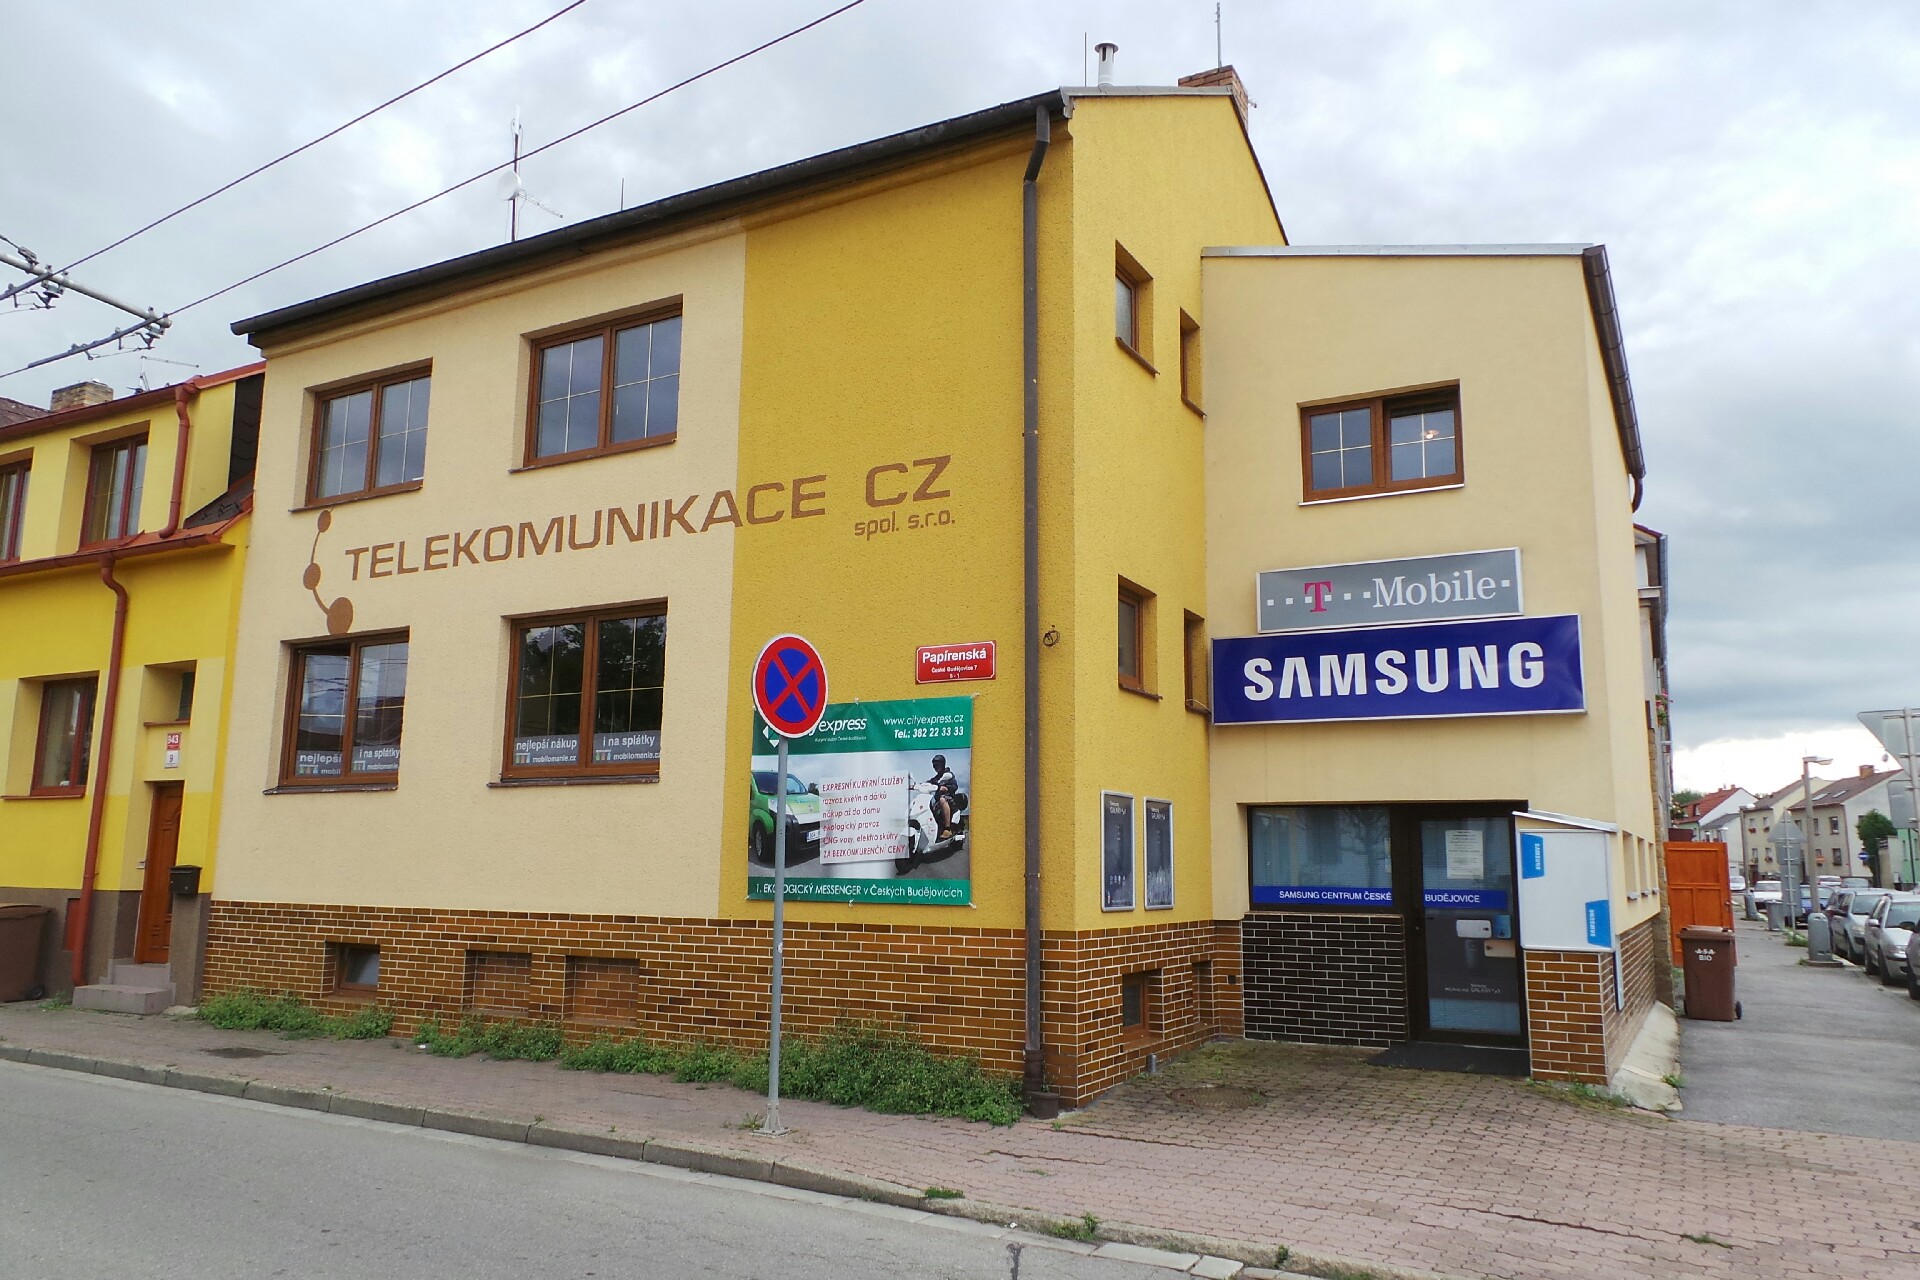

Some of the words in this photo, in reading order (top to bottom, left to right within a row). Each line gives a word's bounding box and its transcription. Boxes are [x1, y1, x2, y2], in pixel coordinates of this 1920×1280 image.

[345, 474, 827, 581] TELEKOMUNIKACE
[865, 454, 952, 509] CZ
[855, 510, 899, 541] spol.
[908, 509, 955, 530] s.r.o.
[1372, 569, 1496, 608] Mobile
[922, 648, 986, 664] Papírenská
[1244, 642, 1544, 702] SAMSUNG
[883, 714, 964, 726] www.cityexpress.cz
[894, 729, 910, 738] Tel.:
[912, 728, 927, 738] 382
[929, 727, 939, 737] 22
[941, 726, 951, 736] 33
[954, 726, 964, 736] 33
[516, 738, 549, 751] nejlepší
[551, 738, 578, 750] nákup
[608, 738, 620, 746] na
[622, 735, 655, 747] splátky
[300, 753, 342, 764] nejlepší
[364, 750, 372, 758] na
[374, 748, 400, 759] splátky
[822, 779, 852, 791] EXPRESNÍ
[881, 776, 905, 786] SLUŽBY
[823, 809, 842, 818] nákup
[862, 807, 881, 815] domu
[823, 821, 856, 831] ekologický
[888, 844, 906, 854] CENY
[763, 883, 814, 894] EKOGICKÝ
[815, 885, 861, 896] MESSENGER
[870, 884, 905, 898] Českých
[907, 887, 963, 898] Budějovicích
[1279, 890, 1320, 899] SAMSUNG
[1321, 892, 1362, 900] CENTRUM
[1364, 891, 1392, 901] ČESKÉ
[1424, 894, 1480, 903] BUDĚJOVICE
